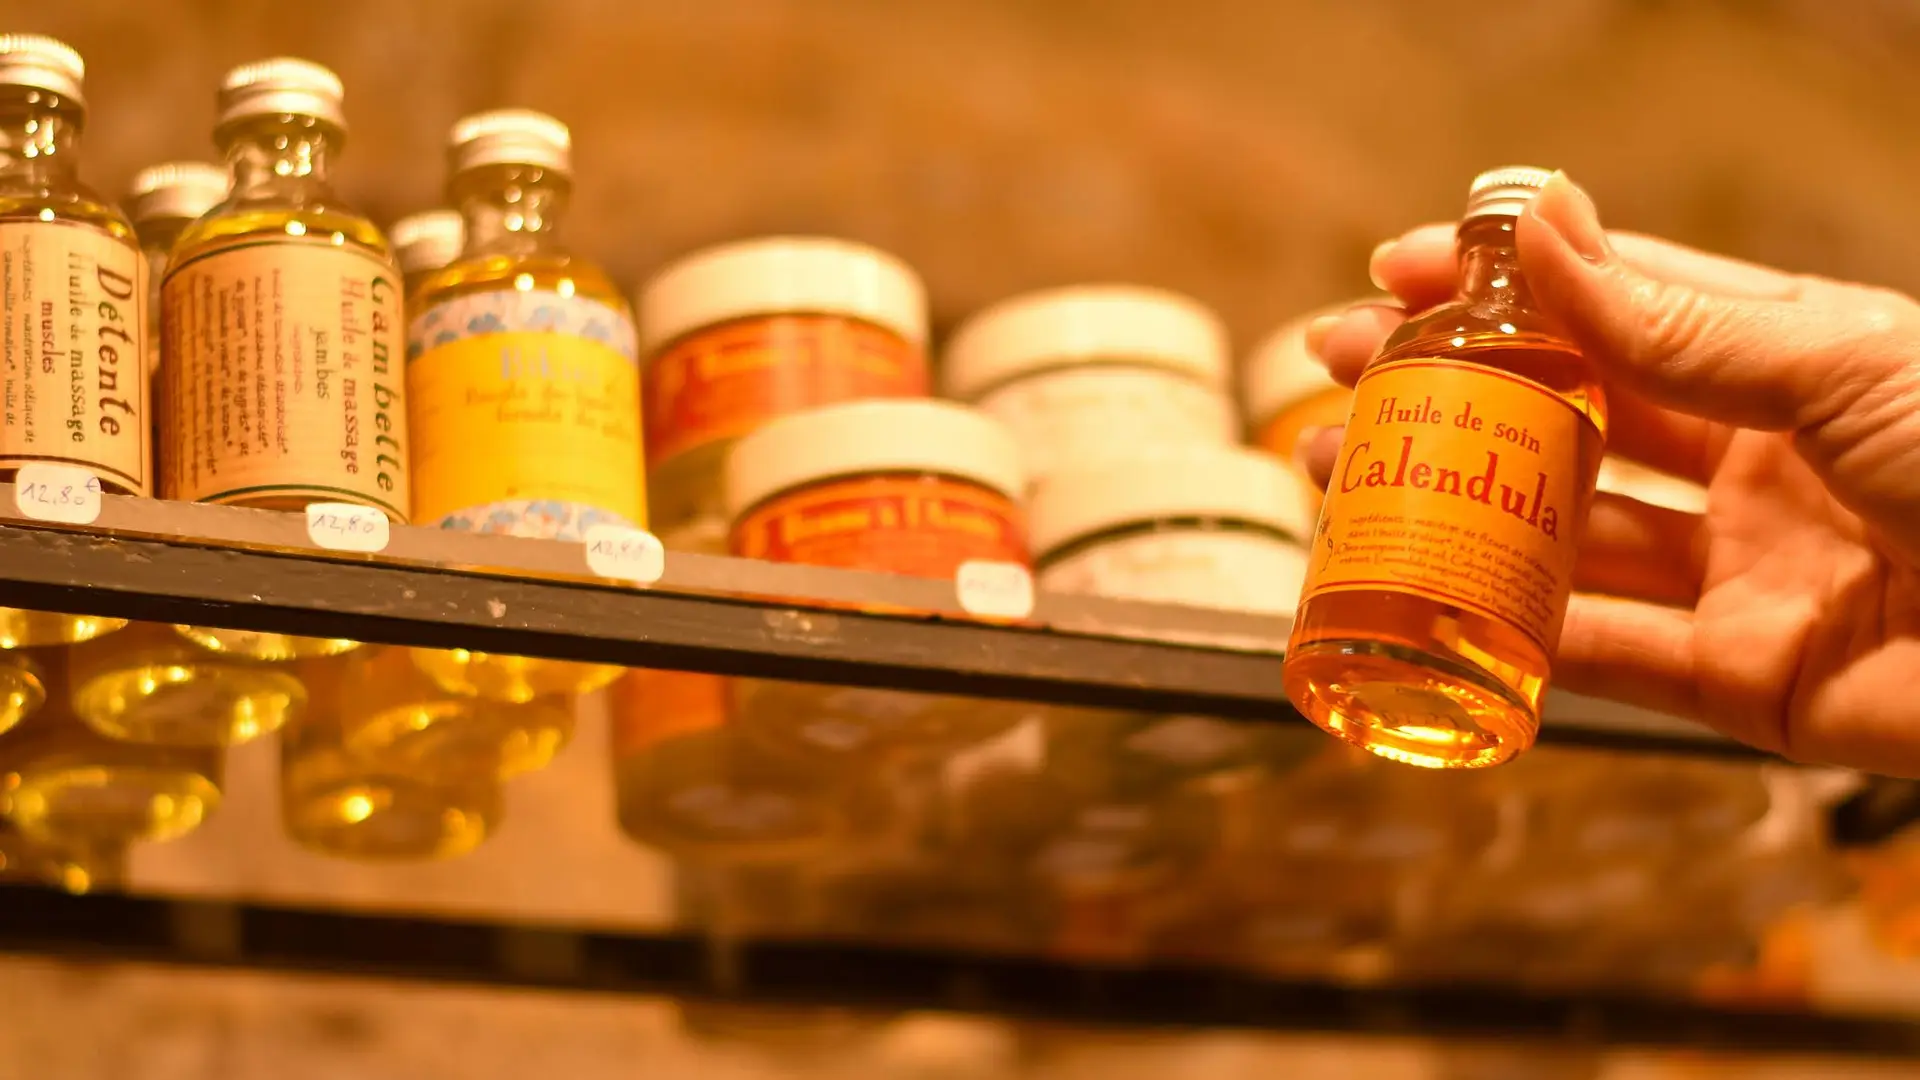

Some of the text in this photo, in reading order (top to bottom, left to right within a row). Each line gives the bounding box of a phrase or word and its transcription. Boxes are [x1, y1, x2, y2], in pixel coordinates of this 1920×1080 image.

[41, 301, 66, 375] muscles
[66, 252, 96, 444] Huile de massage
[97, 263, 136, 437] Détente
[311, 327, 335, 401] jambes
[340, 276, 367, 475] Huile de massage
[371, 276, 402, 493] Gambelle
[1340, 436, 1558, 542] Calendula
[1375, 396, 1541, 455] Huile de soin
